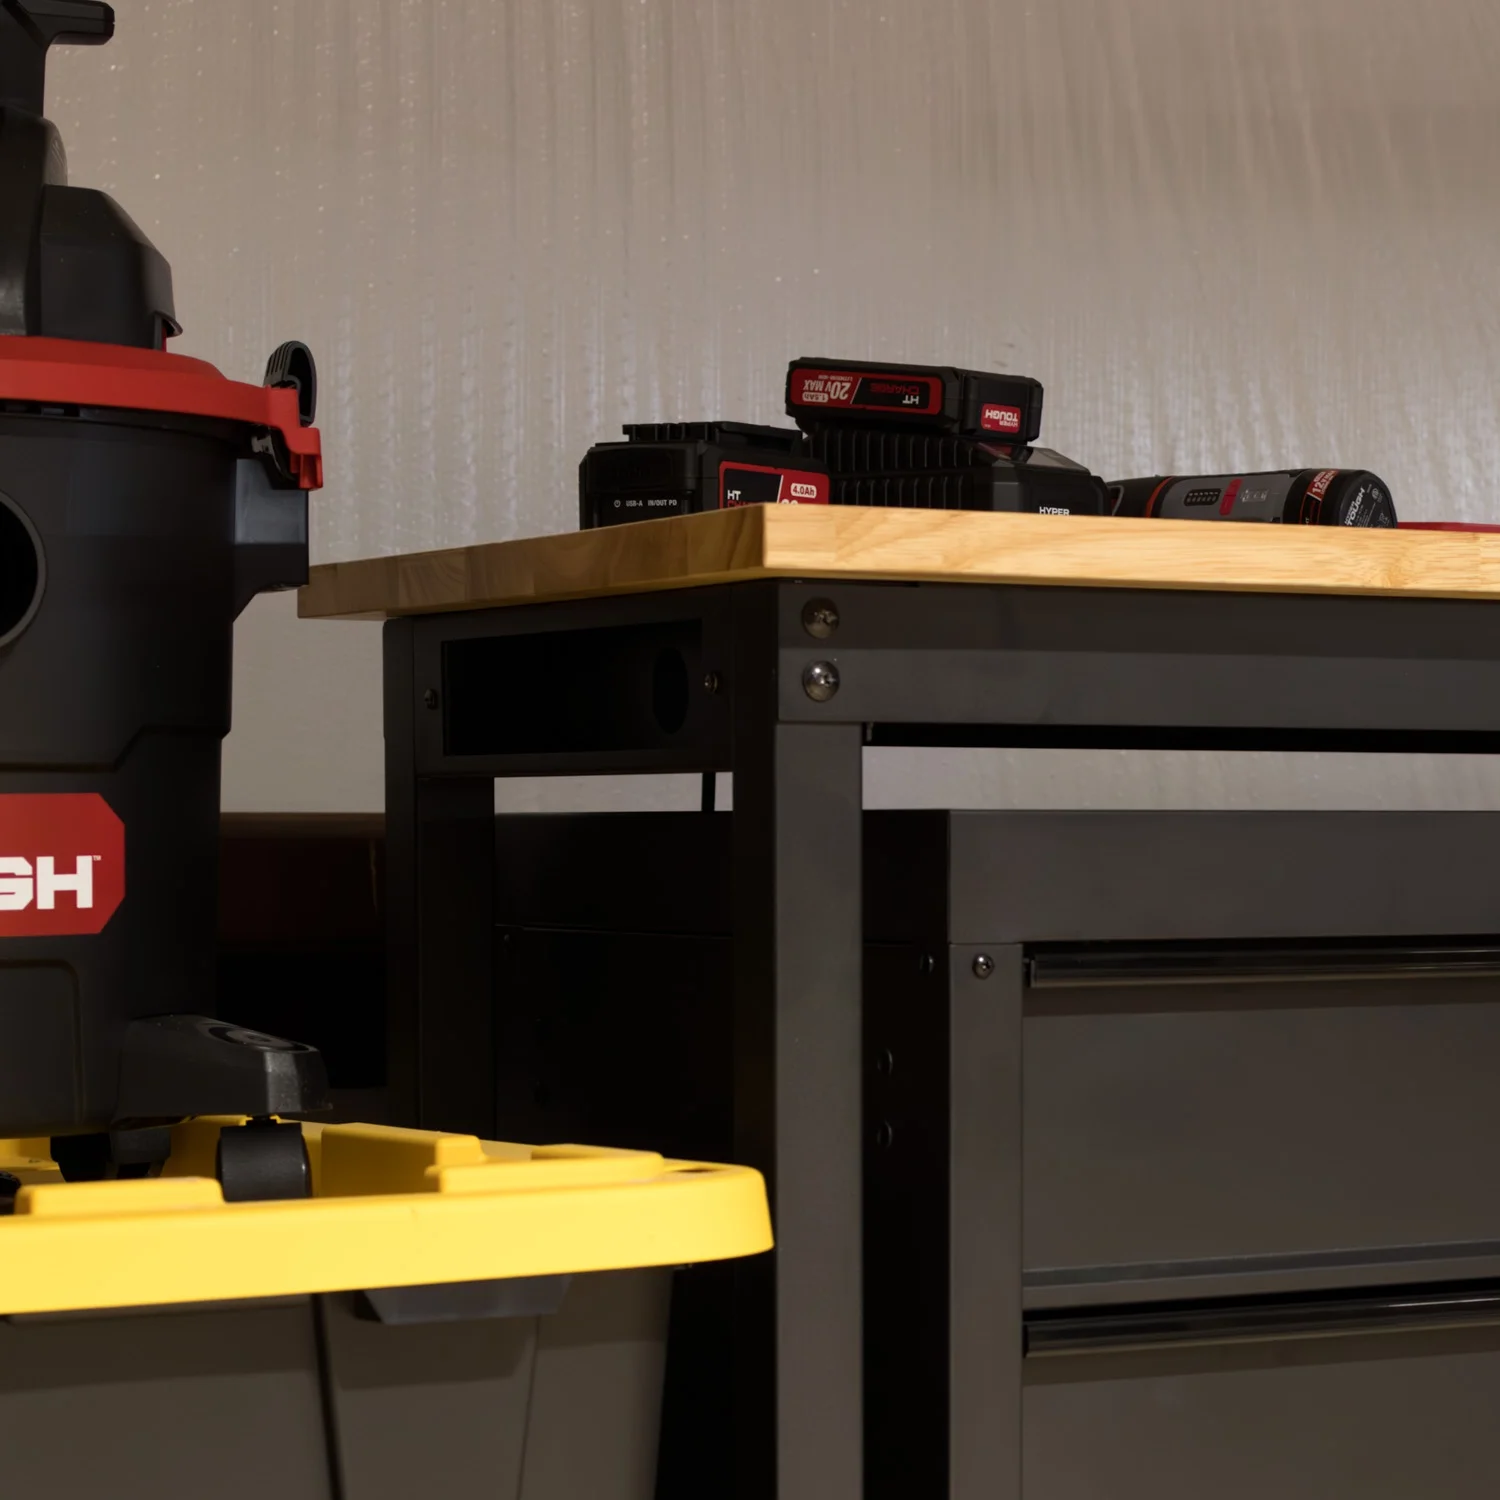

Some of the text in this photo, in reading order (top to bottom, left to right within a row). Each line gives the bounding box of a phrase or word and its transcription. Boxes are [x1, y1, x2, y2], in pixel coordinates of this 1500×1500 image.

[803, 380, 824, 391] MAX
[870, 383, 919, 394] CHARGE
[903, 395, 919, 404] HT
[985, 409, 1018, 421] TOUGH
[727, 489, 741, 501] HT
[792, 485, 815, 496] 4.0Ah
[625, 499, 643, 507] USB-A
[1345, 486, 1365, 525] TOUGH
[1038, 506, 1071, 516] HYPER
